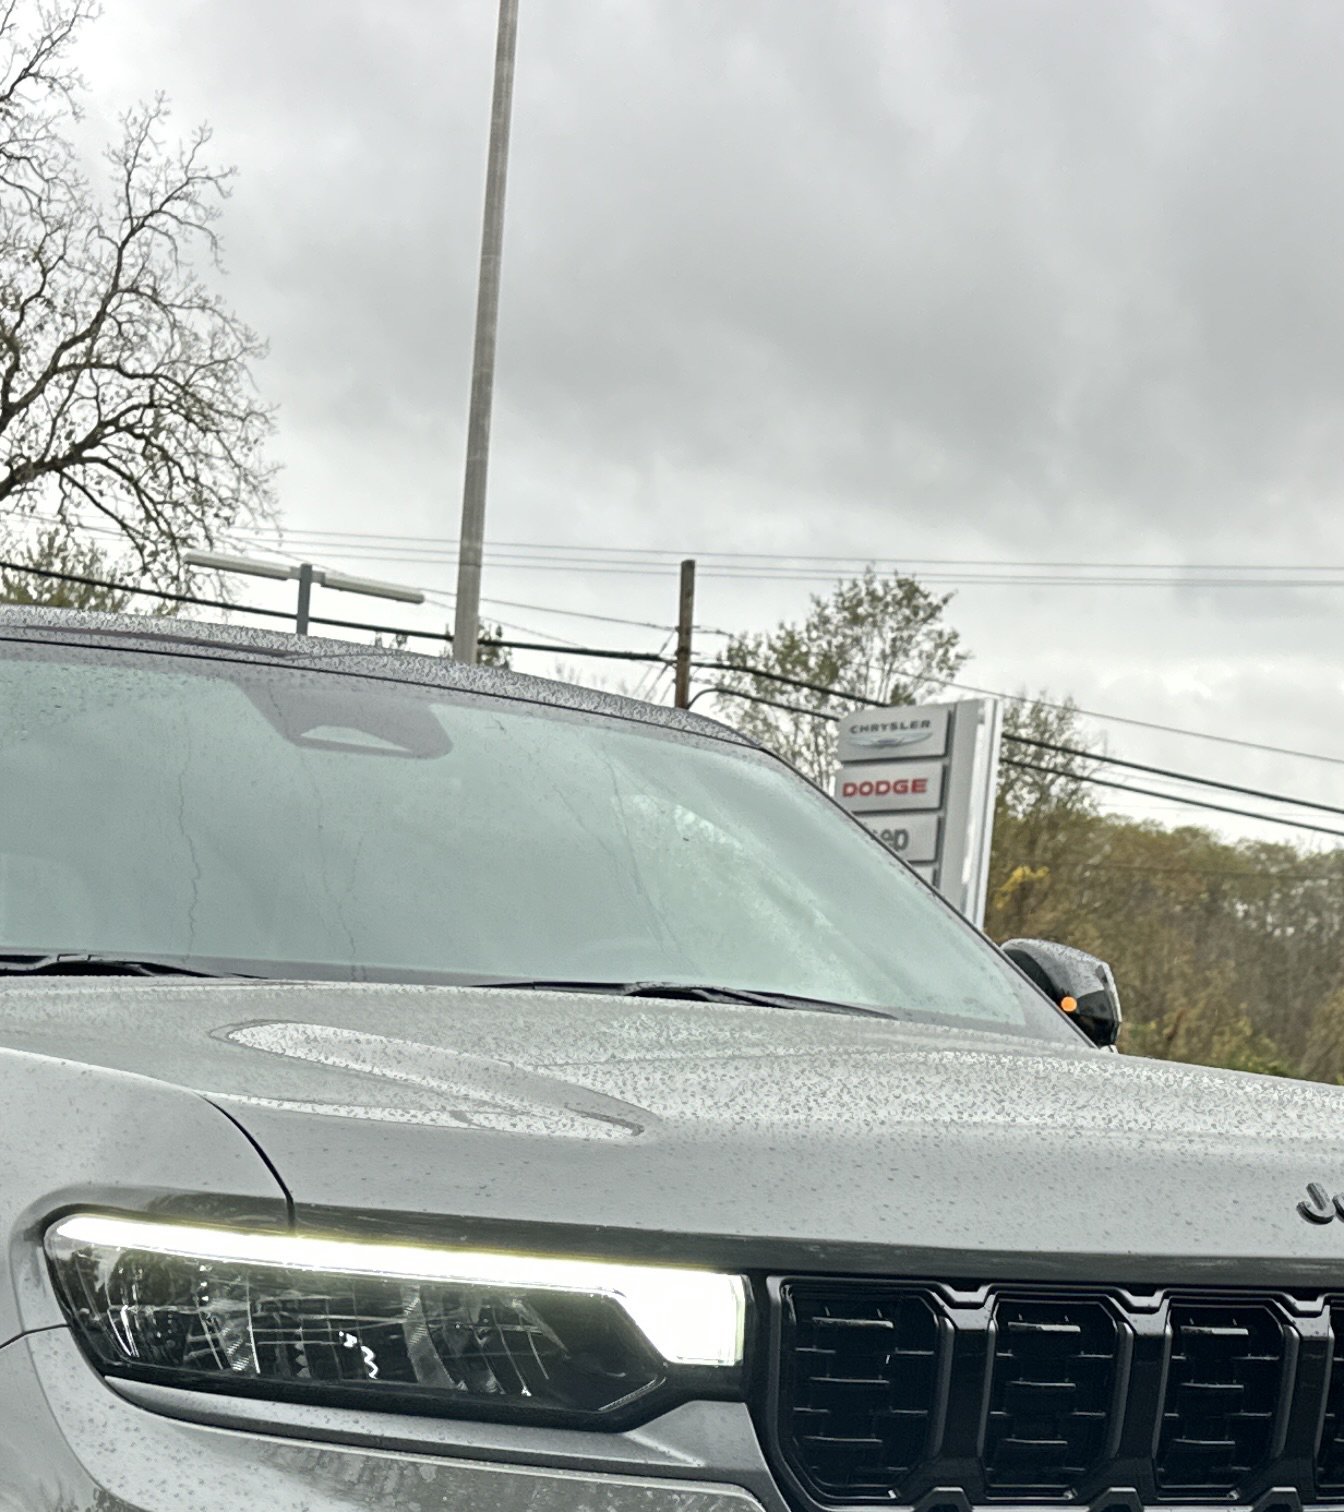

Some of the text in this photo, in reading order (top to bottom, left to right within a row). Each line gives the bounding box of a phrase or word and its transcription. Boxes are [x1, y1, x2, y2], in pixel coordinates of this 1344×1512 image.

[850, 720, 931, 734] CHRYSLER
[842, 778, 928, 797] DODGE
[869, 828, 909, 852] ep
